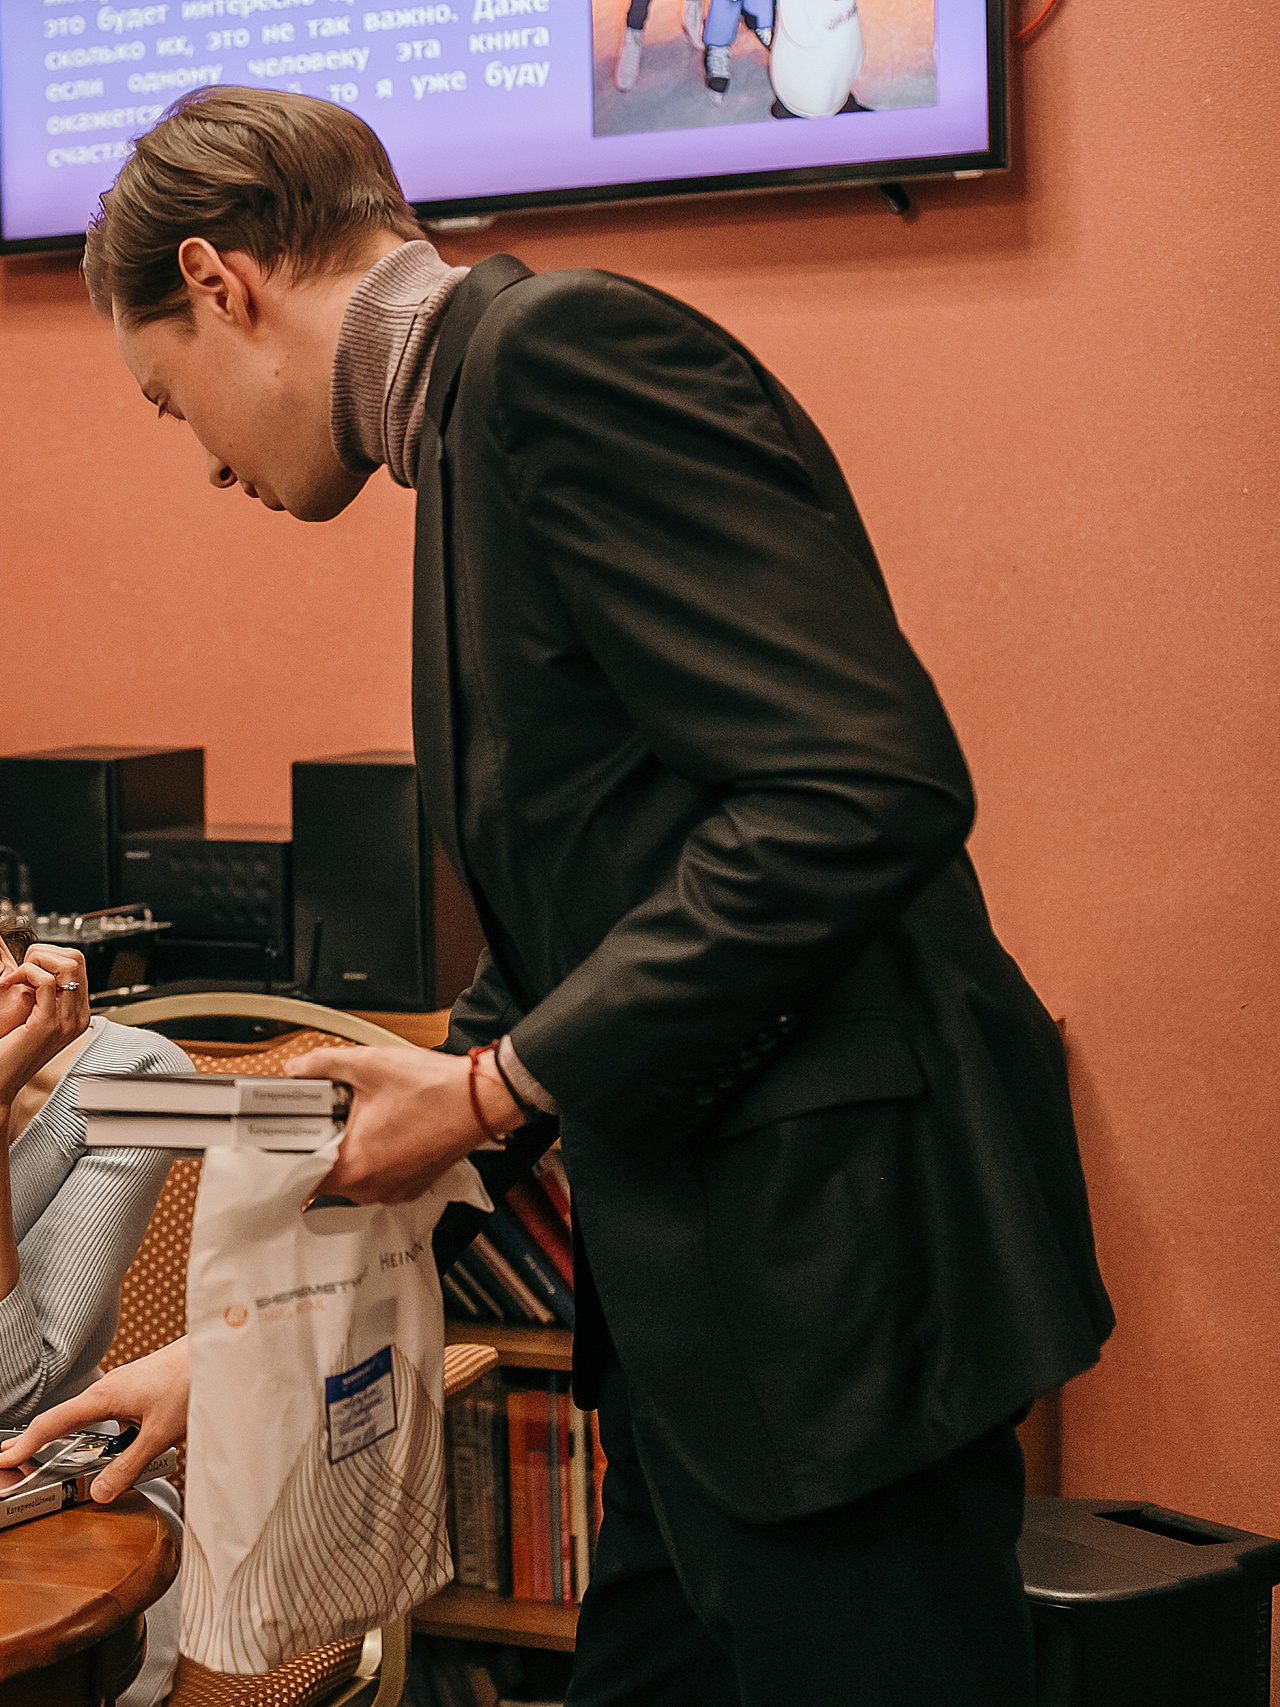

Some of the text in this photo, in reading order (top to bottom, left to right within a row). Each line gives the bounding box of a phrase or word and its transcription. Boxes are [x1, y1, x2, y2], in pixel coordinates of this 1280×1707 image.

[206, 28, 250, 51] это
[305, 15, 351, 39] так
[396, 38, 442, 63] эта
[469, 26, 550, 54] книга
[410, 70, 468, 101] уже
[483, 60, 551, 91] буду
